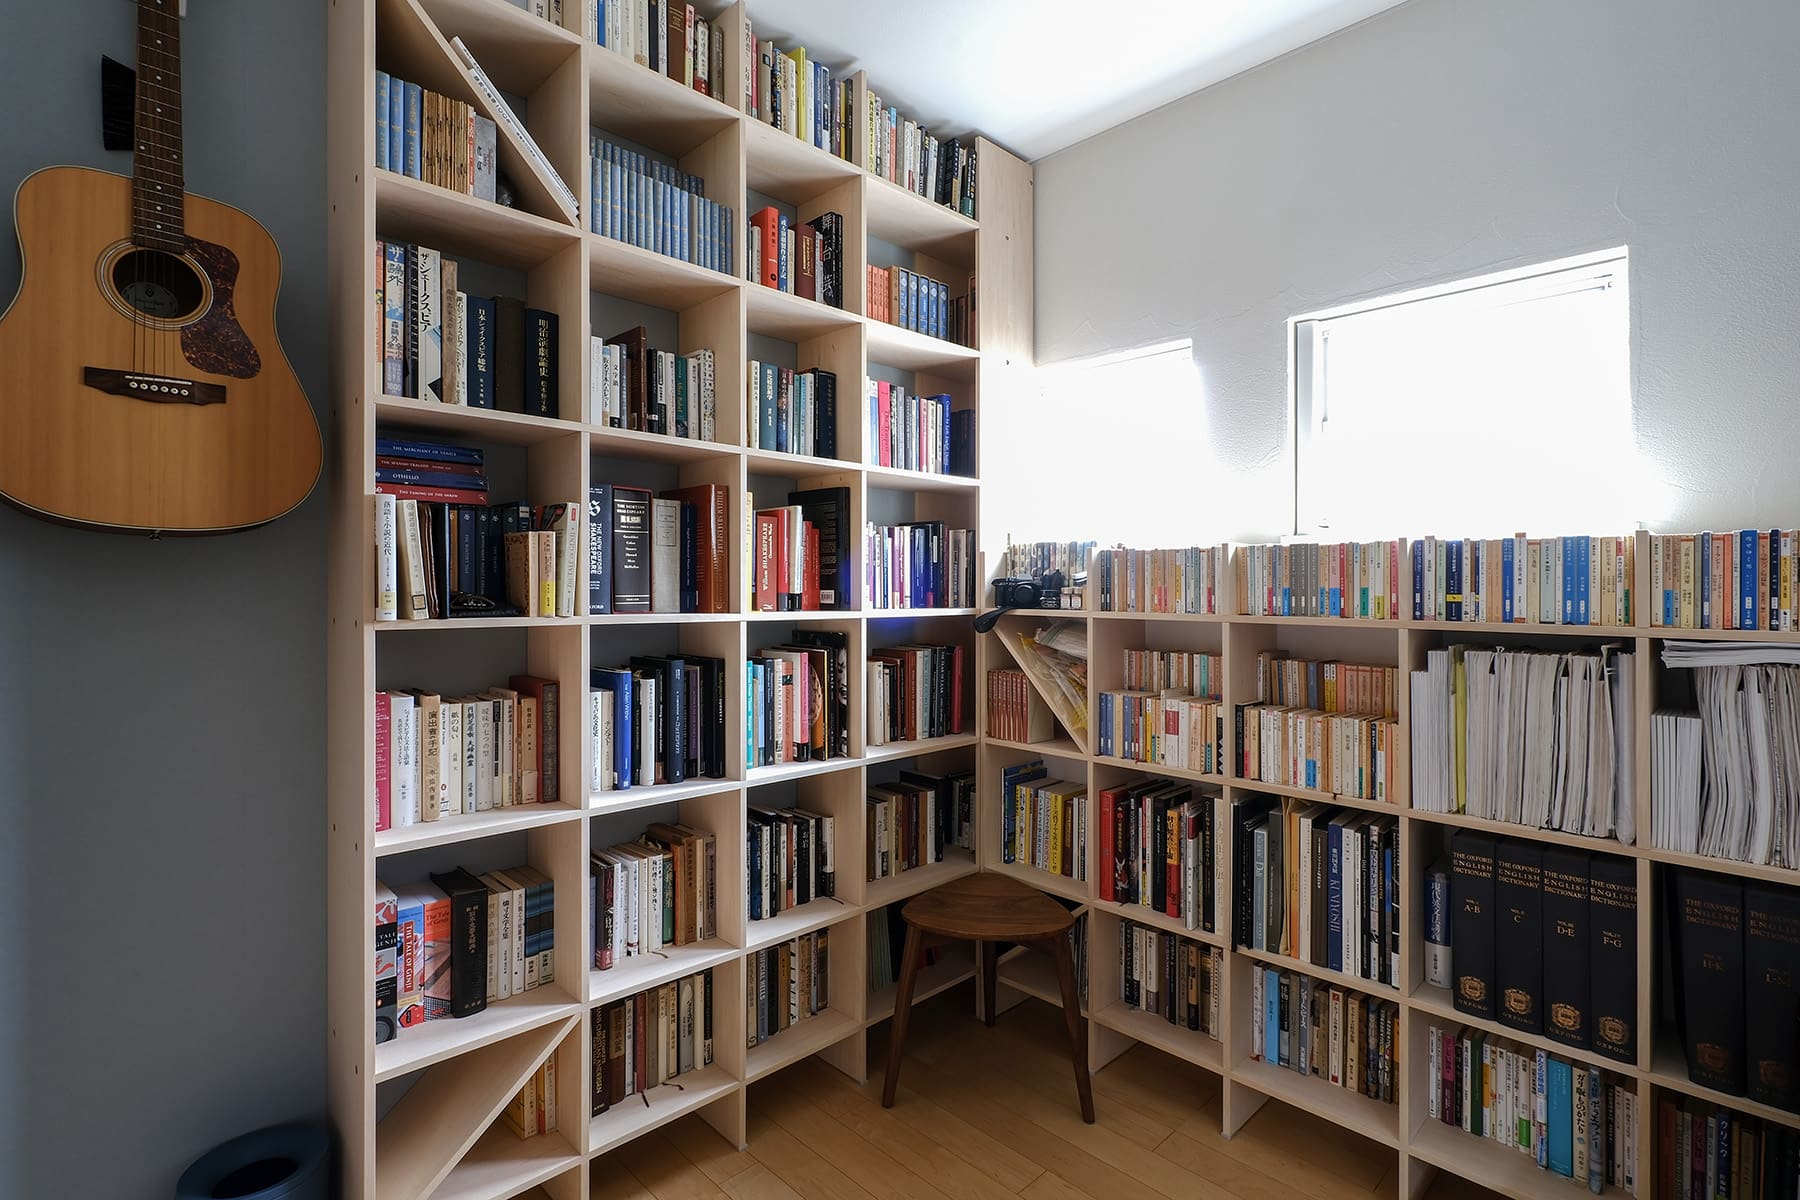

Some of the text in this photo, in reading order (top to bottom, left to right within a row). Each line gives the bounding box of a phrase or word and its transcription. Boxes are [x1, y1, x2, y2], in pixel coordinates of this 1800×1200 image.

[420, 252, 432, 332] ザ・シェークスピア
[451, 712, 459, 740] 紙の匂い
[482, 708, 490, 758] 曖昧の七つの型
[428, 711, 438, 757] 演出者の手記
[1453, 859, 1493, 870] ENGLISH
[1466, 854, 1493, 864] OXFORD
[1453, 866, 1492, 879] DICTIONARY
[1498, 868, 1540, 882] ENGLISH
[1512, 864, 1540, 874] OXFORD
[1498, 875, 1540, 889] DICTIONARY
[1544, 870, 1588, 884] THE OXFORD
[1544, 878, 1588, 892] ENGLISH
[1590, 879, 1637, 892] THE OXFORD
[1544, 886, 1587, 900] DICTIONARY
[1590, 888, 1637, 900] ENGLISH
[1330, 880, 1340, 933] KUNIYOSHI
[1590, 895, 1637, 910] DICTIONARY
[1686, 908, 1739, 922] ENGLISH
[406, 957, 412, 966] OF
[1576, 1073, 1586, 1134] ガリ版ものがたり
